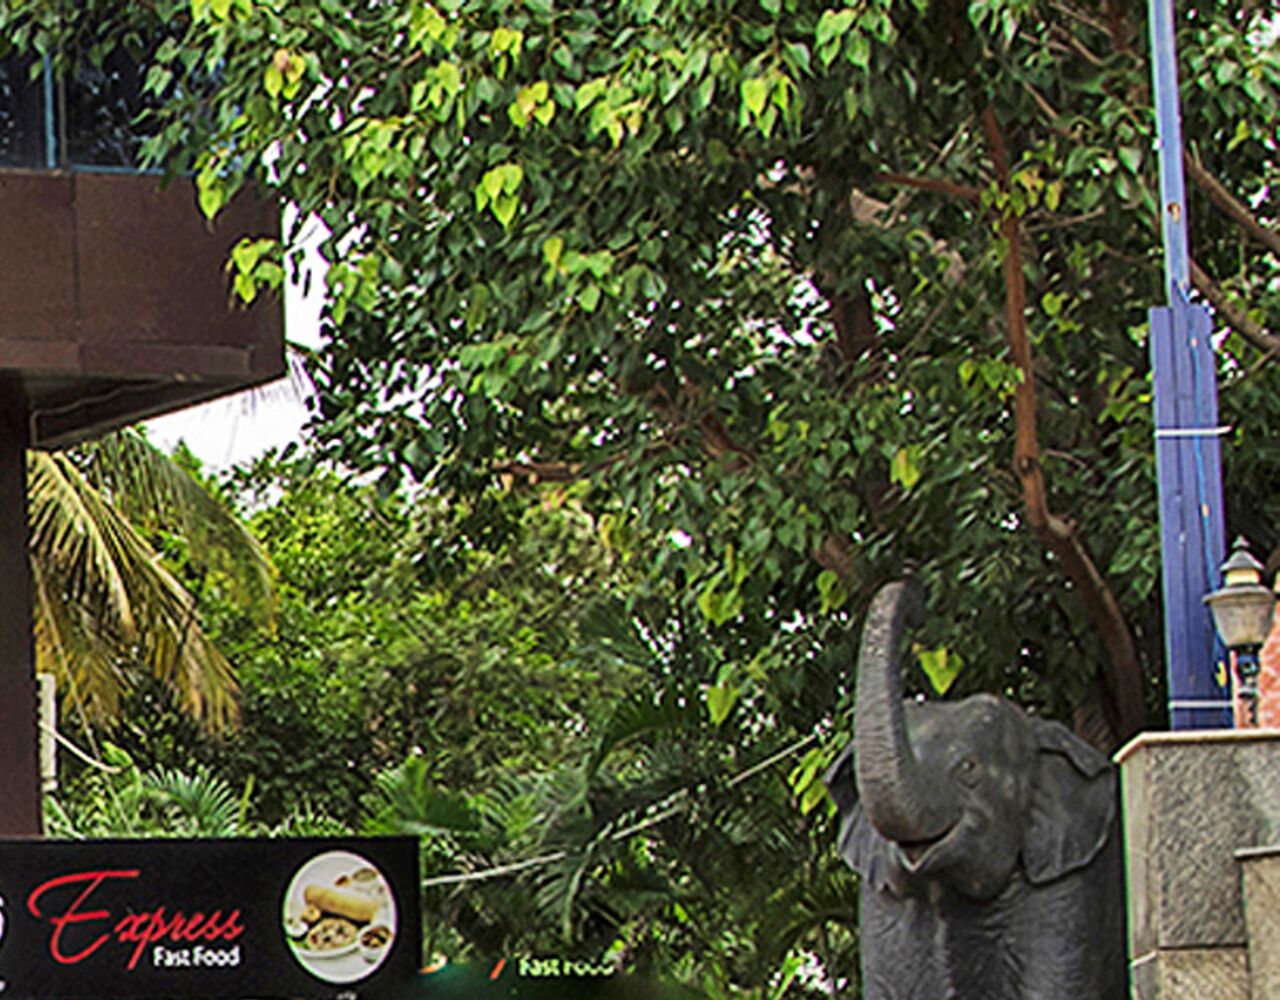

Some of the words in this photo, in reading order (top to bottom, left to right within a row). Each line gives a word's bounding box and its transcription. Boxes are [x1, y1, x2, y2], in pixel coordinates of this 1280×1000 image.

[27, 869, 245, 970] Express
[153, 945, 191, 967] Fast
[192, 945, 240, 967] Food
